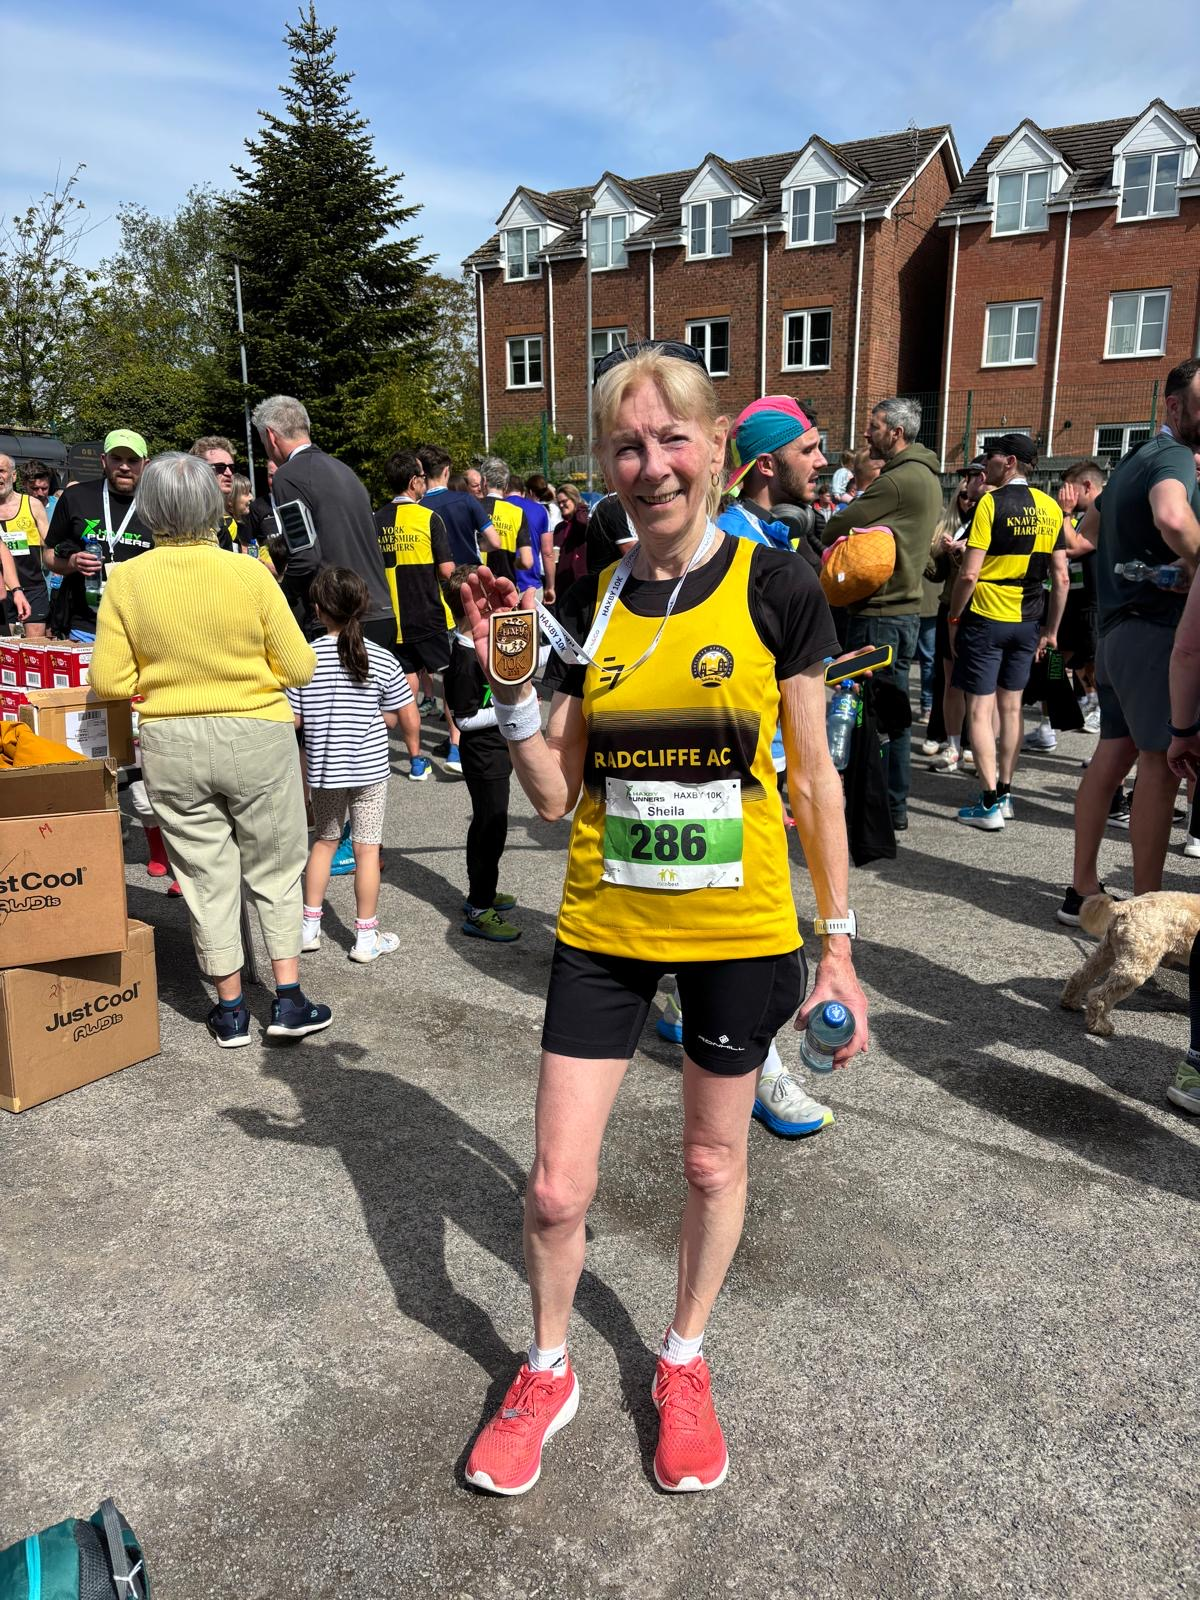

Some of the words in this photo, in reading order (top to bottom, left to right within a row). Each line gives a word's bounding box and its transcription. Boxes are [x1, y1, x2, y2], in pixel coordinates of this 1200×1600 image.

[1023, 506, 1047, 516] YORK
[1006, 516, 1058, 528] KNAVESMIRE
[382, 526, 404, 535] YORK
[1013, 526, 1054, 537] HARRIERS
[377, 534, 420, 544] NAVESMIRE
[7, 541, 19, 550] 81
[602, 591, 617, 617] HAXBY
[613, 576, 623, 592] 10K
[539, 613, 559, 638] HAXBY
[554, 637, 567, 653] 10K
[502, 655, 526, 672] 10K
[594, 749, 701, 769] RADCLIFFE
[706, 747, 732, 768] AC
[673, 791, 704, 799] HAXBY
[706, 791, 723, 799] 10K
[647, 806, 685, 817] Sheila
[629, 823, 707, 862] 286
[73, 1013, 123, 1042] AWDis
